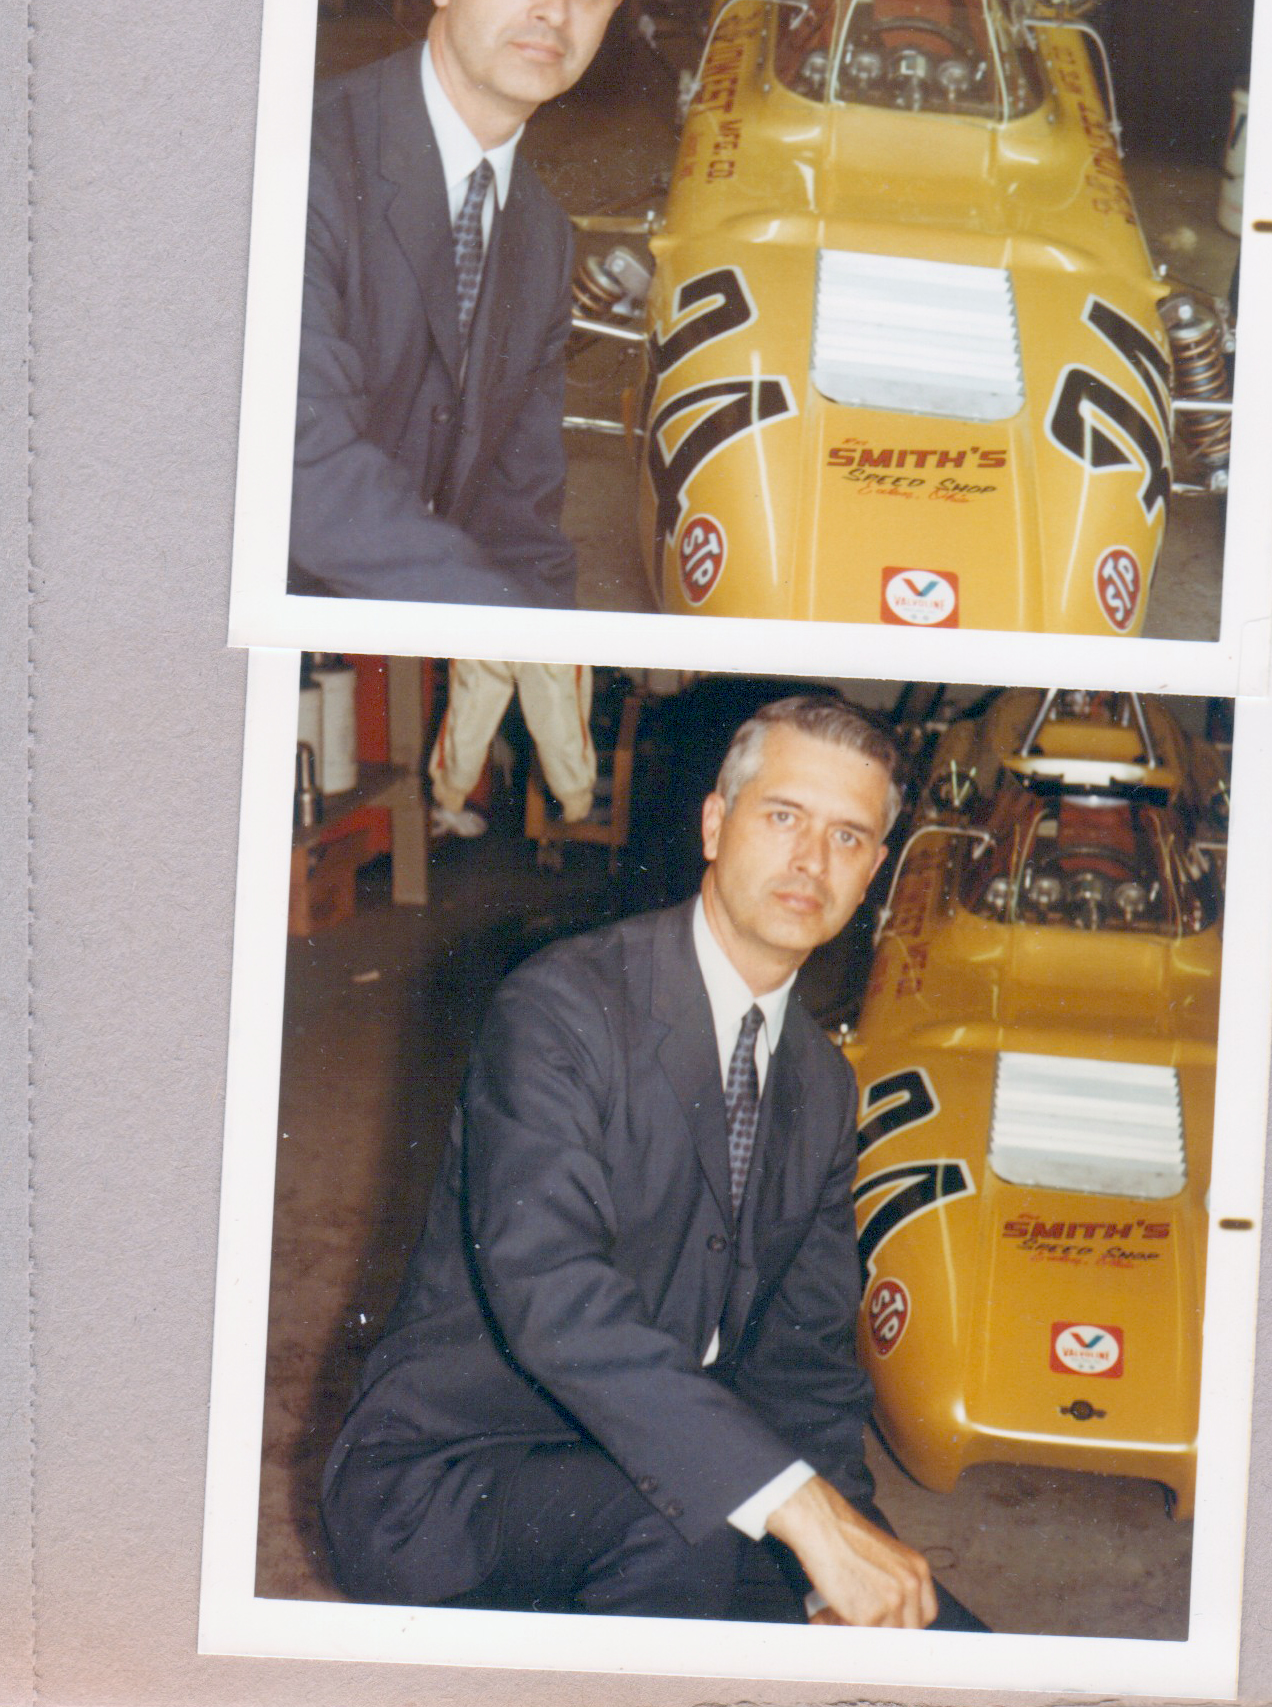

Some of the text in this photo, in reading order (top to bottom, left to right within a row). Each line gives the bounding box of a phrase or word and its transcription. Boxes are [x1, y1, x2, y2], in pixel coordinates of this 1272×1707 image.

[826, 446, 1008, 469] SMITH'S
[842, 467, 997, 494] SPEED SHOP
[683, 526, 720, 586] STP
[1102, 557, 1135, 622] STP
[1001, 1220, 1170, 1239] SMITH'S
[871, 1288, 905, 1341] STP
